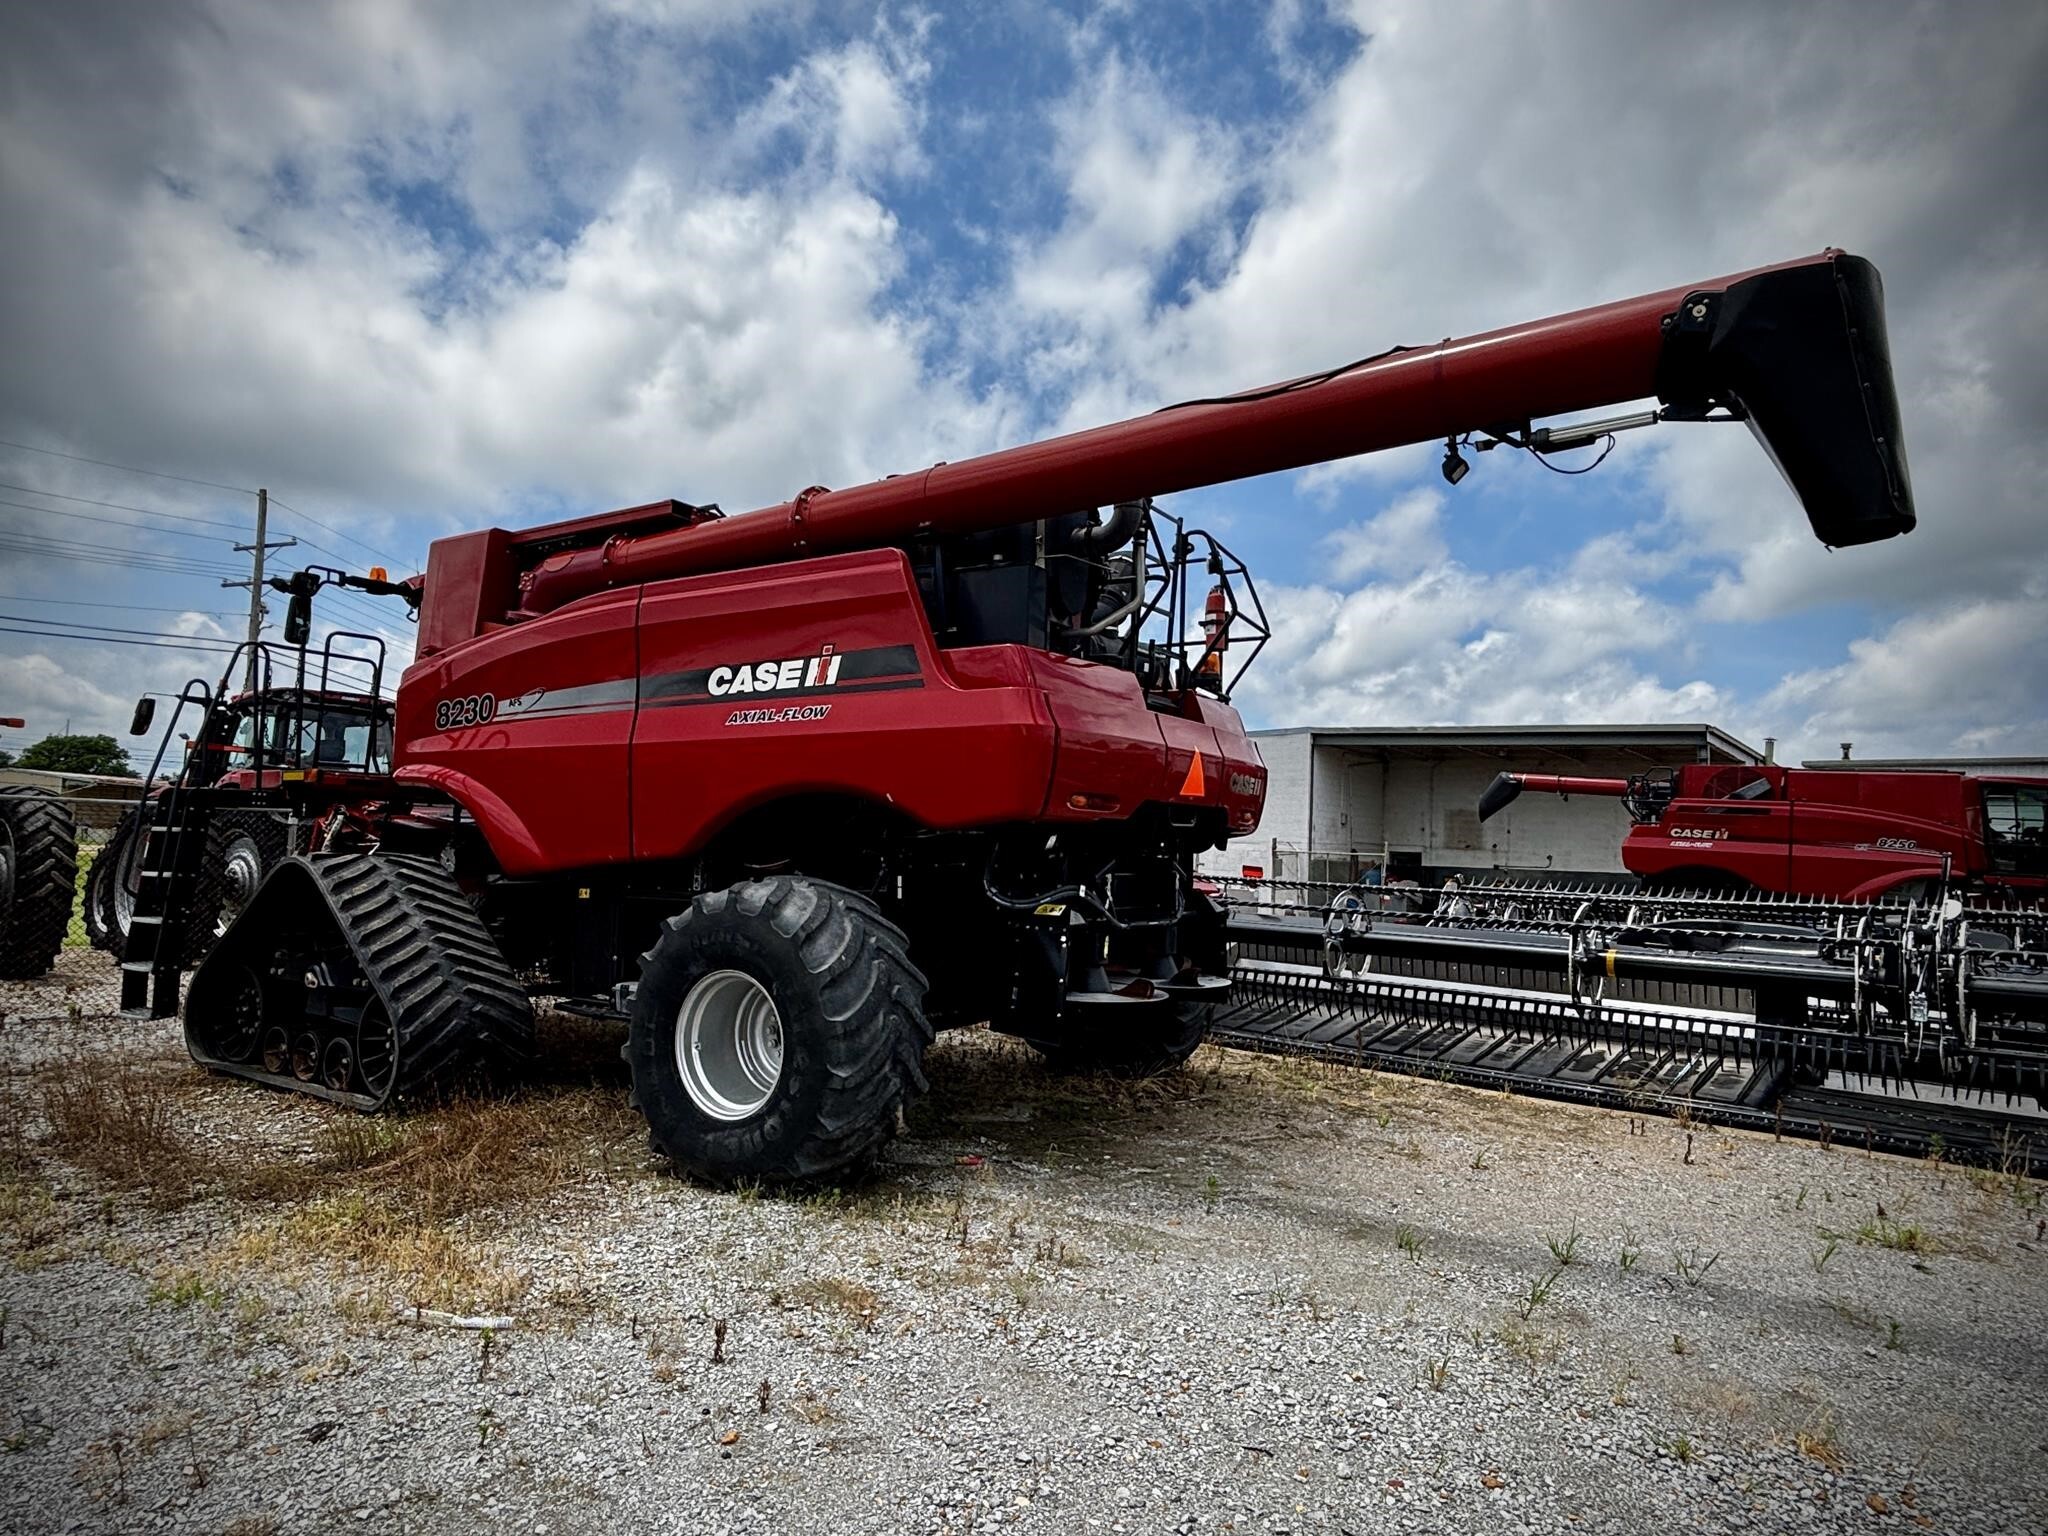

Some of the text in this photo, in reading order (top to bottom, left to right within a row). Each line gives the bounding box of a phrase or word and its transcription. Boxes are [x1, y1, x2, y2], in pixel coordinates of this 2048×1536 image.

[707, 659, 804, 696] CASE
[435, 693, 495, 731] 8230
[508, 698, 522, 708] AFS
[725, 704, 832, 726] AXIAL-FLOW
[1230, 772, 1254, 795] CASE
[1670, 828, 1714, 839] CASE
[1876, 837, 1917, 850] 8250
